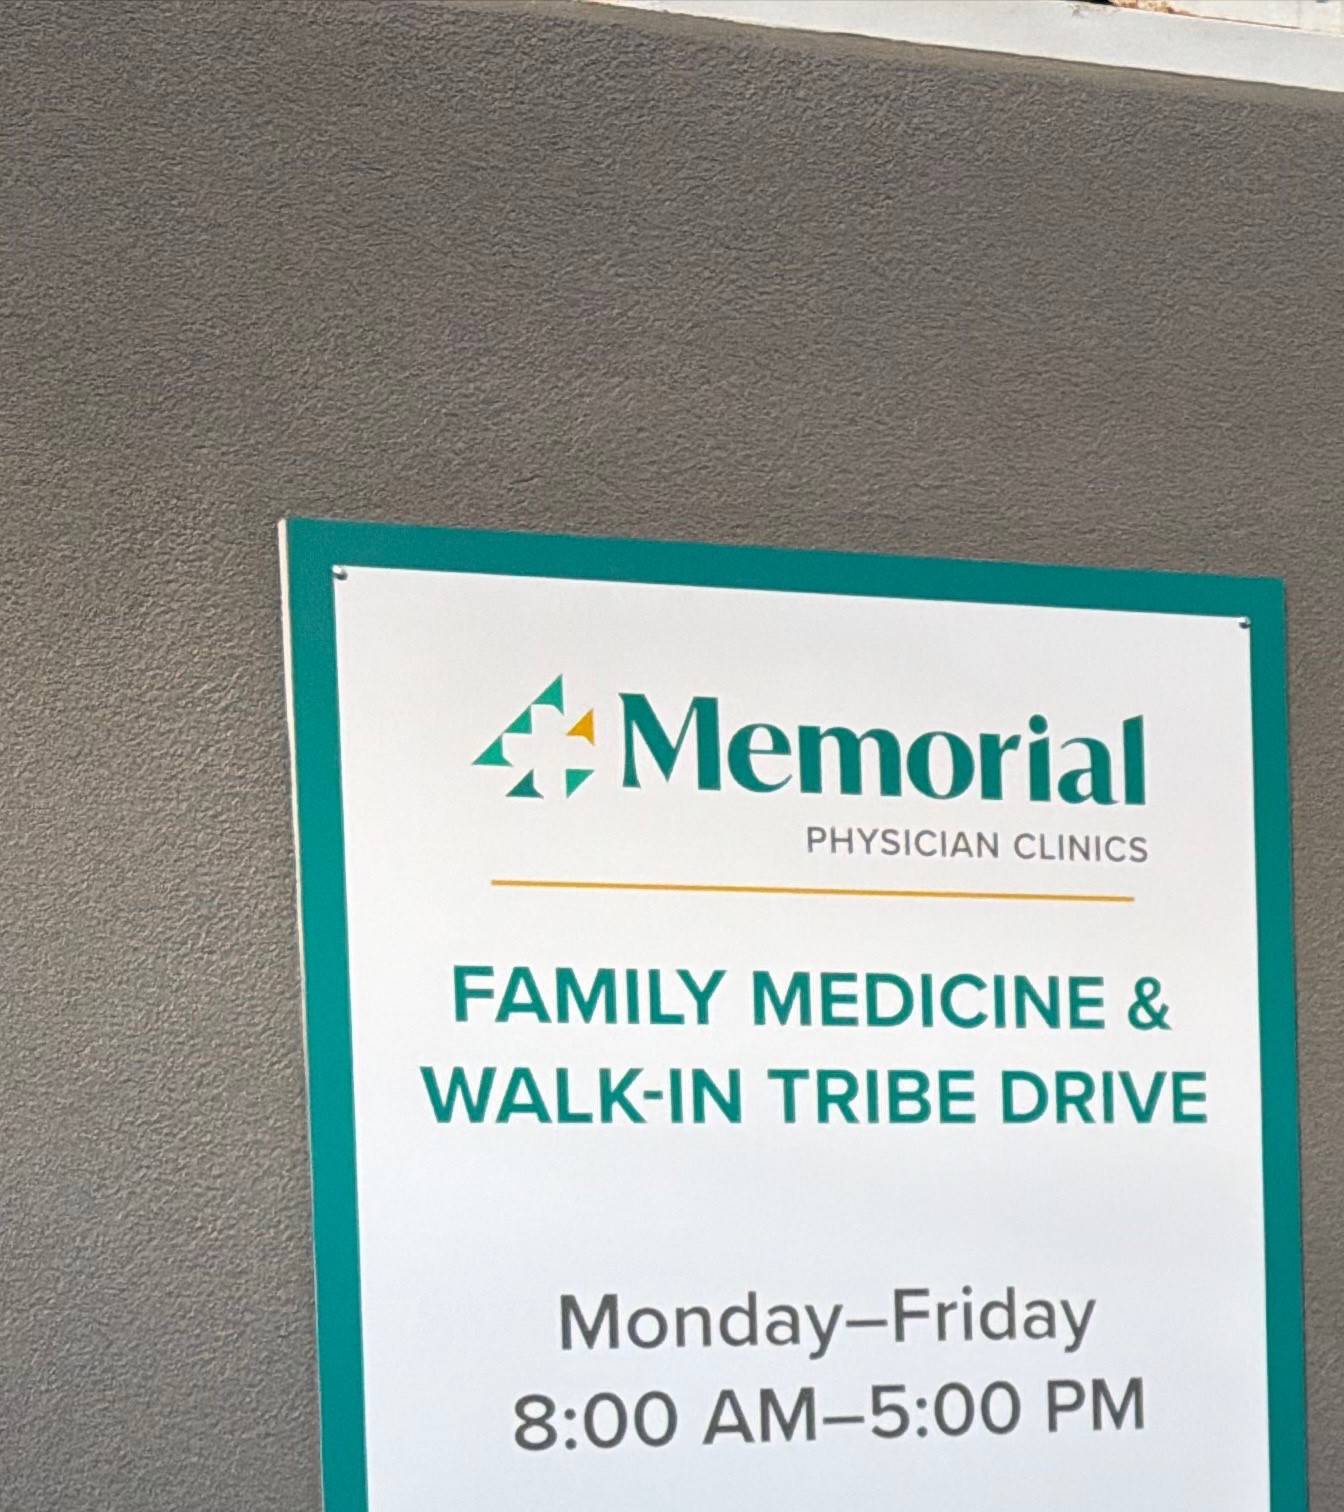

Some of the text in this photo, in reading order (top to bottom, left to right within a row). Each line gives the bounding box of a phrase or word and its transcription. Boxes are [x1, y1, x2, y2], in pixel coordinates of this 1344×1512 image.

[618, 692, 1147, 808] Memorial
[806, 825, 1149, 864] PHYSICIAN CLINICS
[452, 964, 1172, 1032] FAMILY MEDICINE &
[418, 1065, 1209, 1126] WALK-IN TRIBE DRIVE
[513, 1389, 679, 1452] 8:00
[1046, 1376, 1145, 1434] PM
